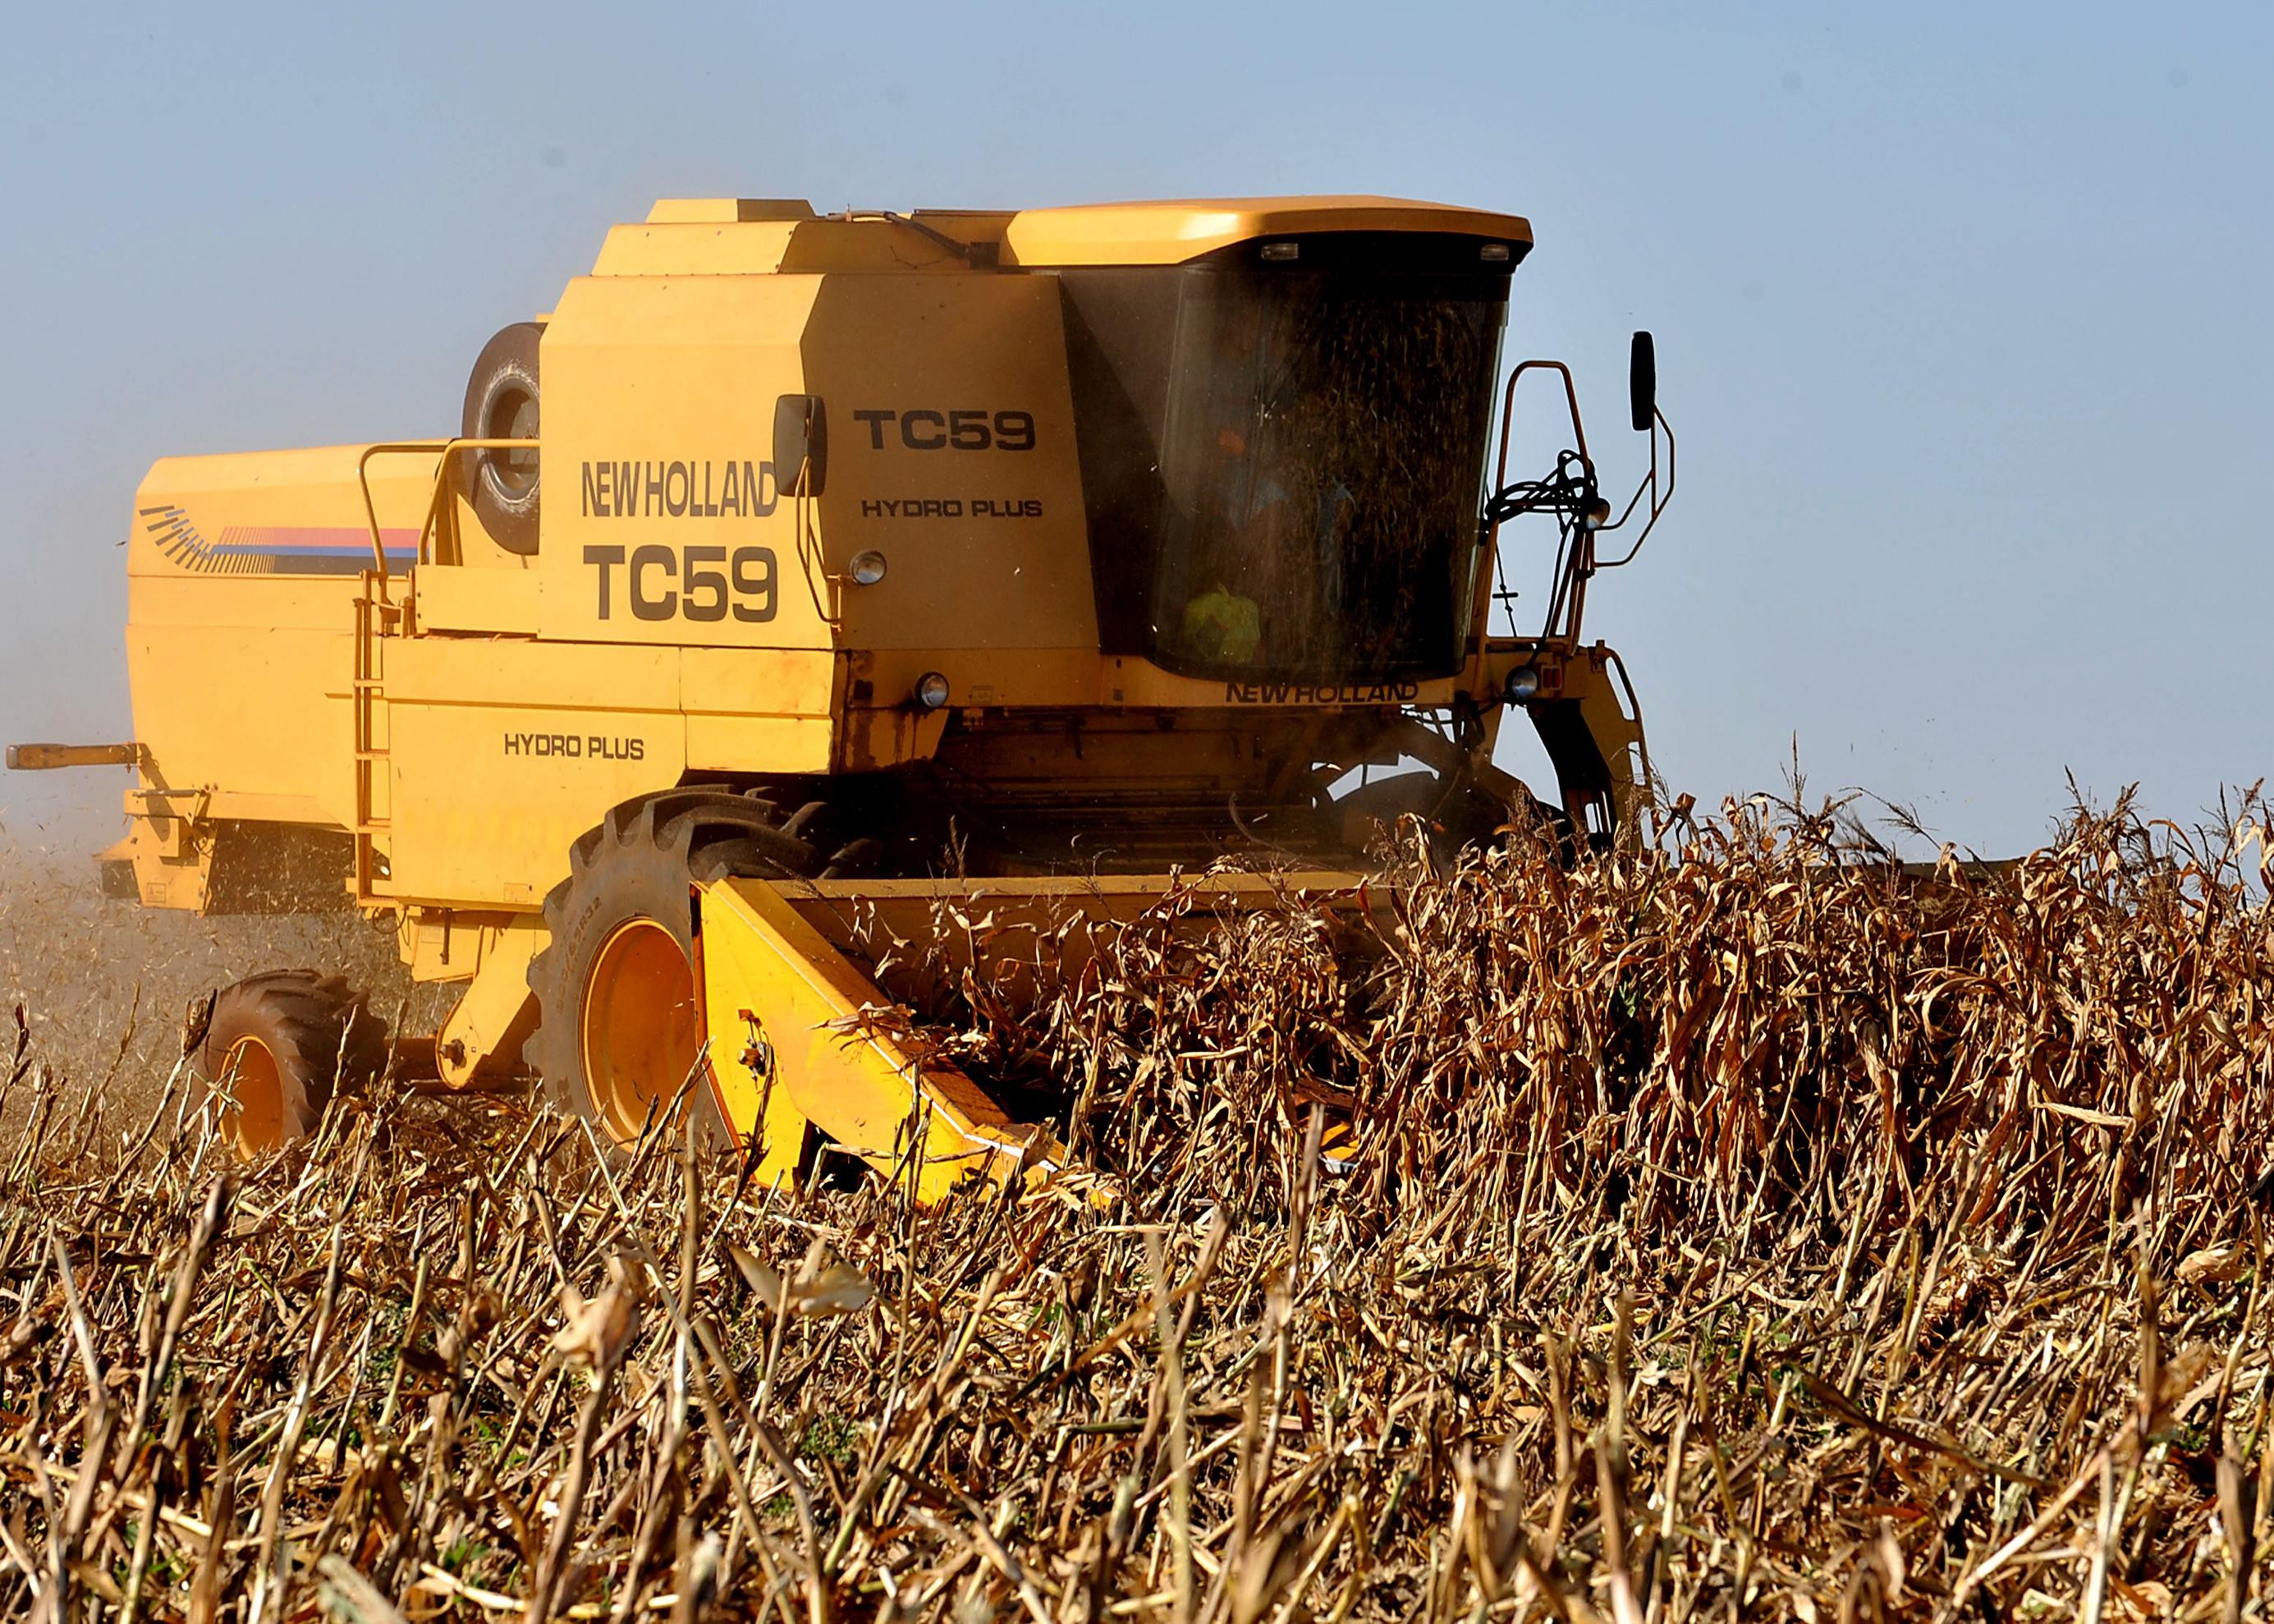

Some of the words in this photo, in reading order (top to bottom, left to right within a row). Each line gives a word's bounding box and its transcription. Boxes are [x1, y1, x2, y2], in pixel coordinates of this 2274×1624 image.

[854, 410, 1035, 451] TC59
[582, 461, 640, 517] NEW
[644, 461, 778, 517] HOLLAND
[862, 499, 963, 518] HYDRO
[971, 499, 1043, 518] PLUS
[583, 544, 778, 623] TC59
[1225, 682, 1291, 704] NEW
[1295, 682, 1419, 704] HOLLAND
[504, 733, 581, 758] HYDRO
[588, 736, 644, 760] PLUS
